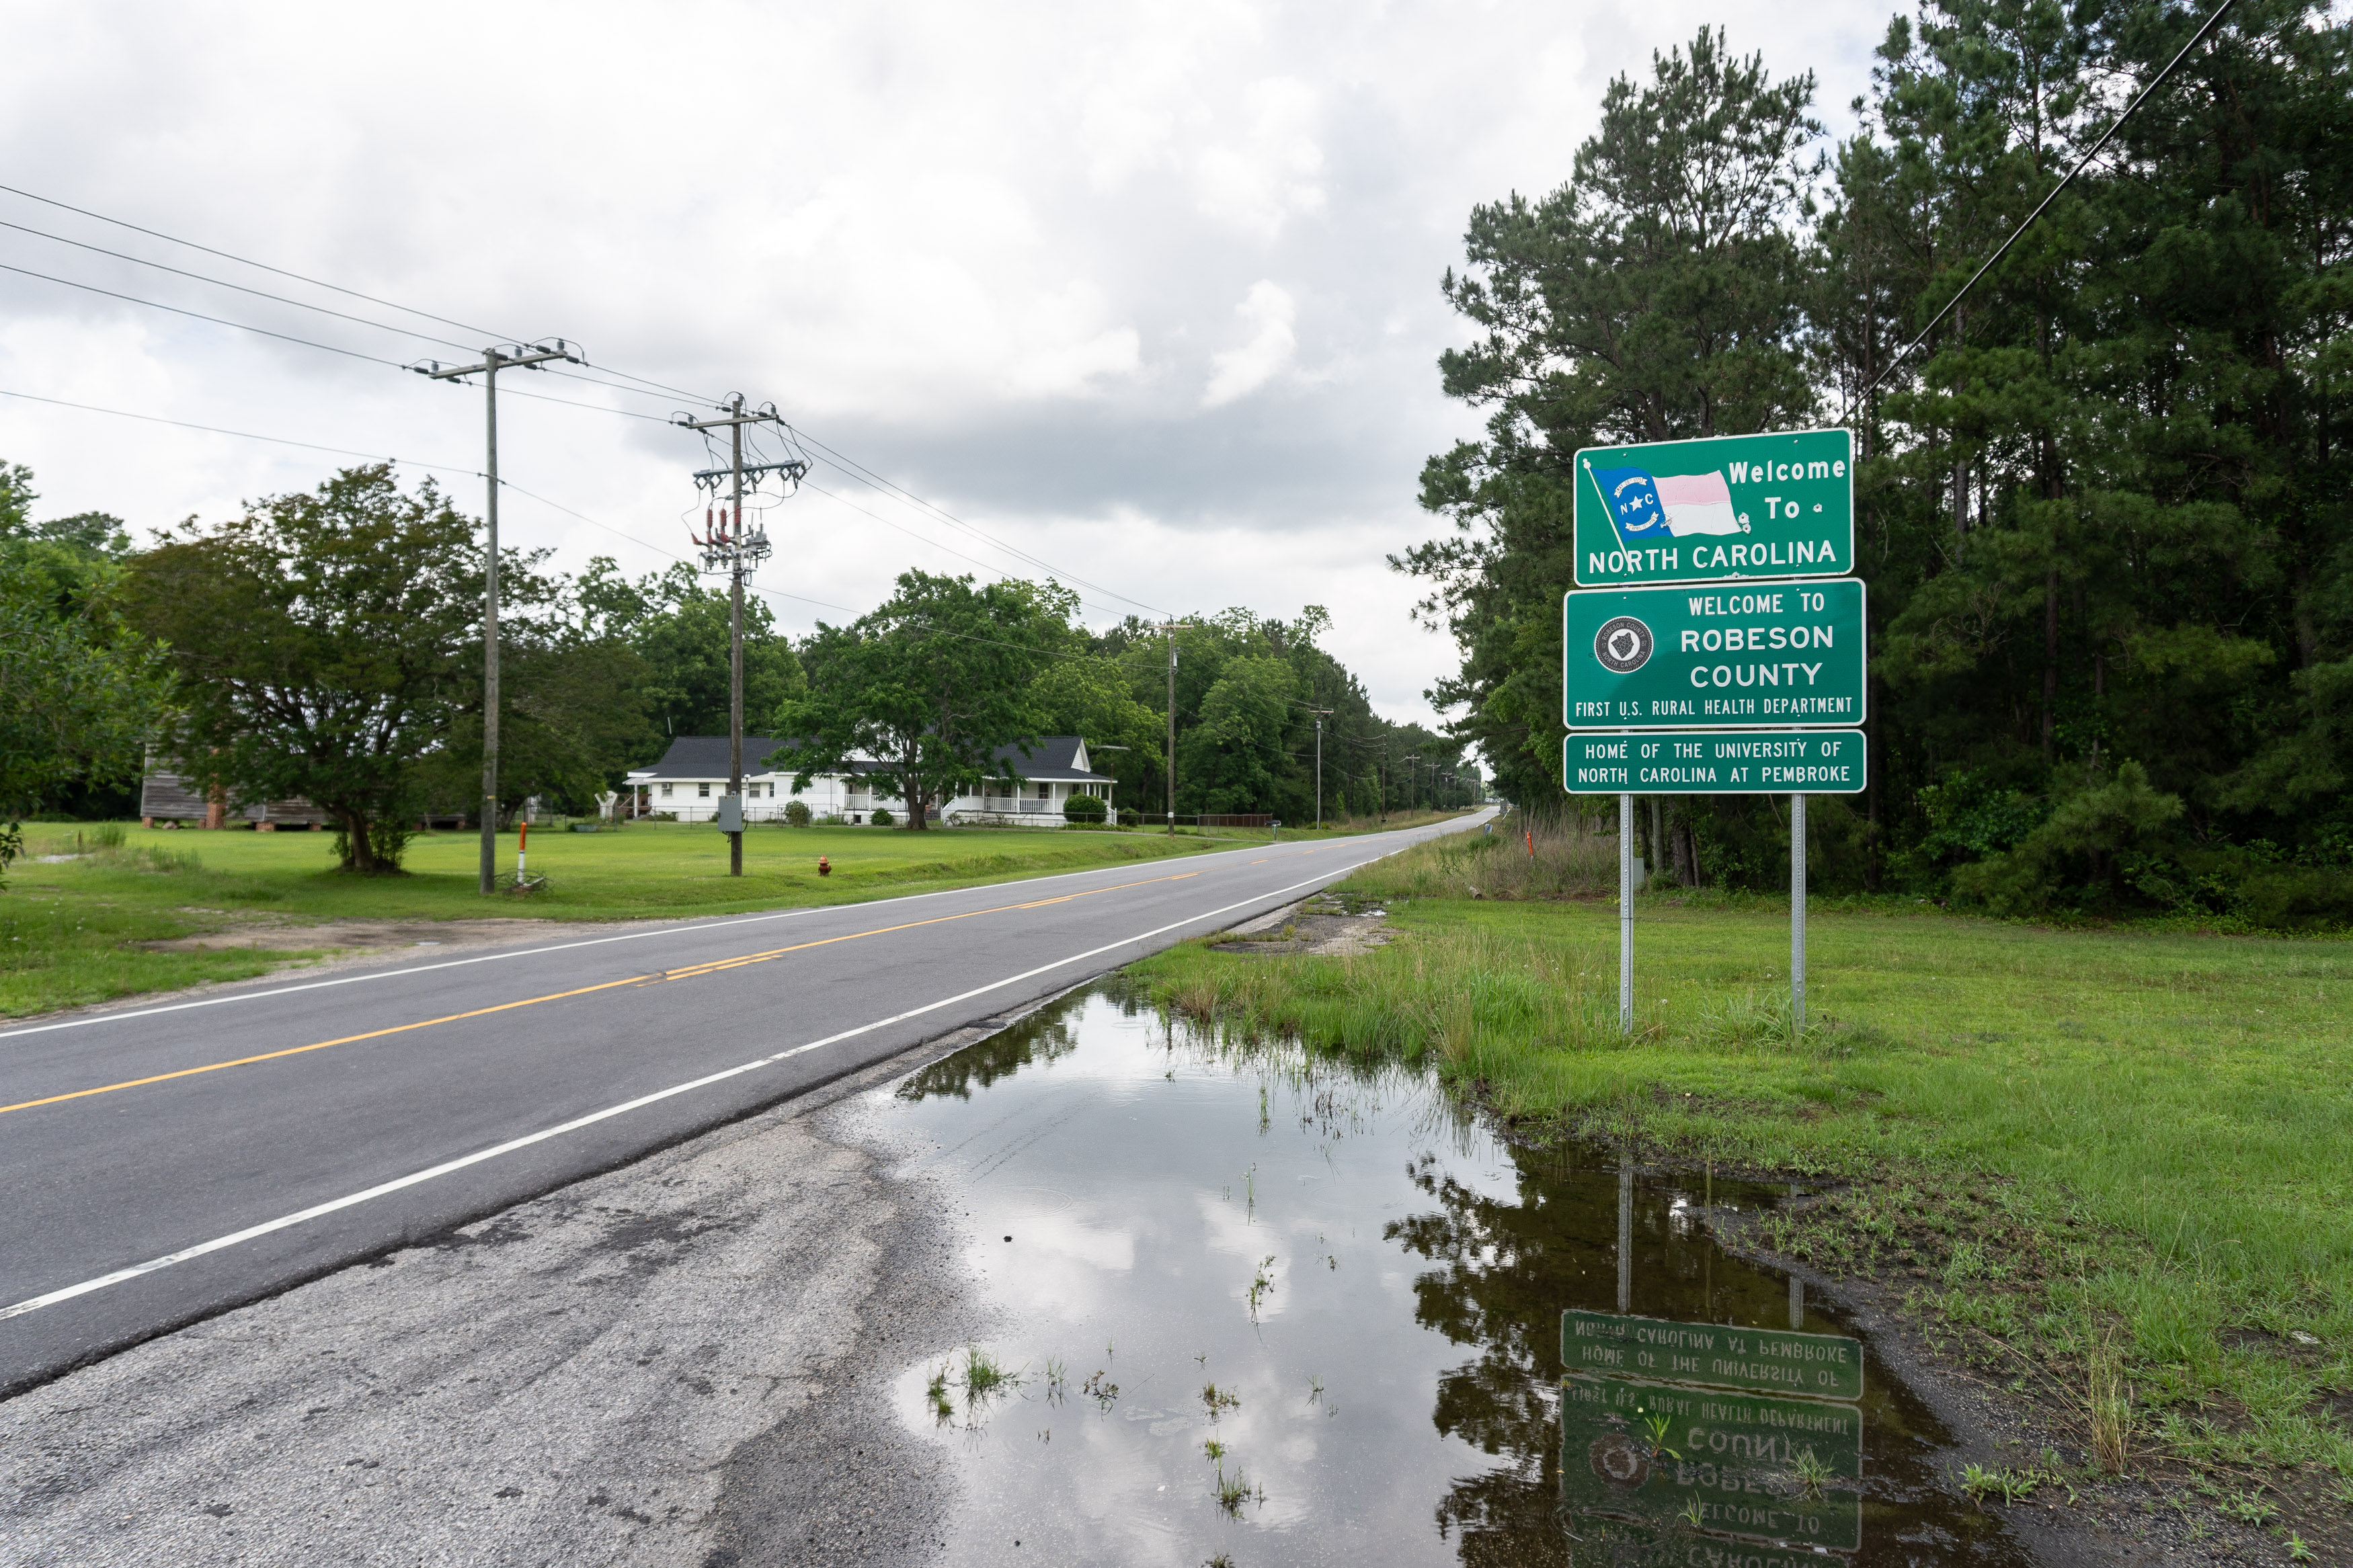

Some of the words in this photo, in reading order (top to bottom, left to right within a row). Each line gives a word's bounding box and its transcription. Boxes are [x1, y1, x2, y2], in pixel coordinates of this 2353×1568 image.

[1728, 460, 1845, 484] Welcome
[1620, 503, 1628, 515] N
[1644, 493, 1653, 504] C
[1765, 497, 1800, 519] To
[1589, 548, 1678, 573] NORTH
[1693, 540, 1837, 568] CAROLINA
[1689, 594, 1784, 616] WELCOME
[1800, 593, 1825, 612] TO
[1601, 622, 1624, 641] ROBESON
[1627, 622, 1646, 638] COUNTY
[1681, 625, 1833, 652] ROBESON
[1602, 651, 1619, 667] NORTH
[1620, 651, 1646, 668] CAROLINA
[1690, 663, 1823, 688] COUNTY
[1576, 702, 1610, 716] FIRST
[1620, 701, 1642, 716] U.S.
[1652, 700, 1696, 715] RURAL
[1704, 699, 1755, 714] HEALTH
[1763, 697, 1852, 714] DEPARTMENT
[1585, 744, 1628, 759] HOME
[1640, 743, 1661, 758] OF
[1673, 743, 1703, 758] THE
[1715, 741, 1807, 758] UNIVERSITY
[1821, 741, 1842, 757] OF
[1579, 768, 1627, 783] NORTH
[1640, 768, 1717, 782] CAROLINA
[1730, 768, 1749, 782] AT
[1762, 766, 1850, 782] PEMBROKE
